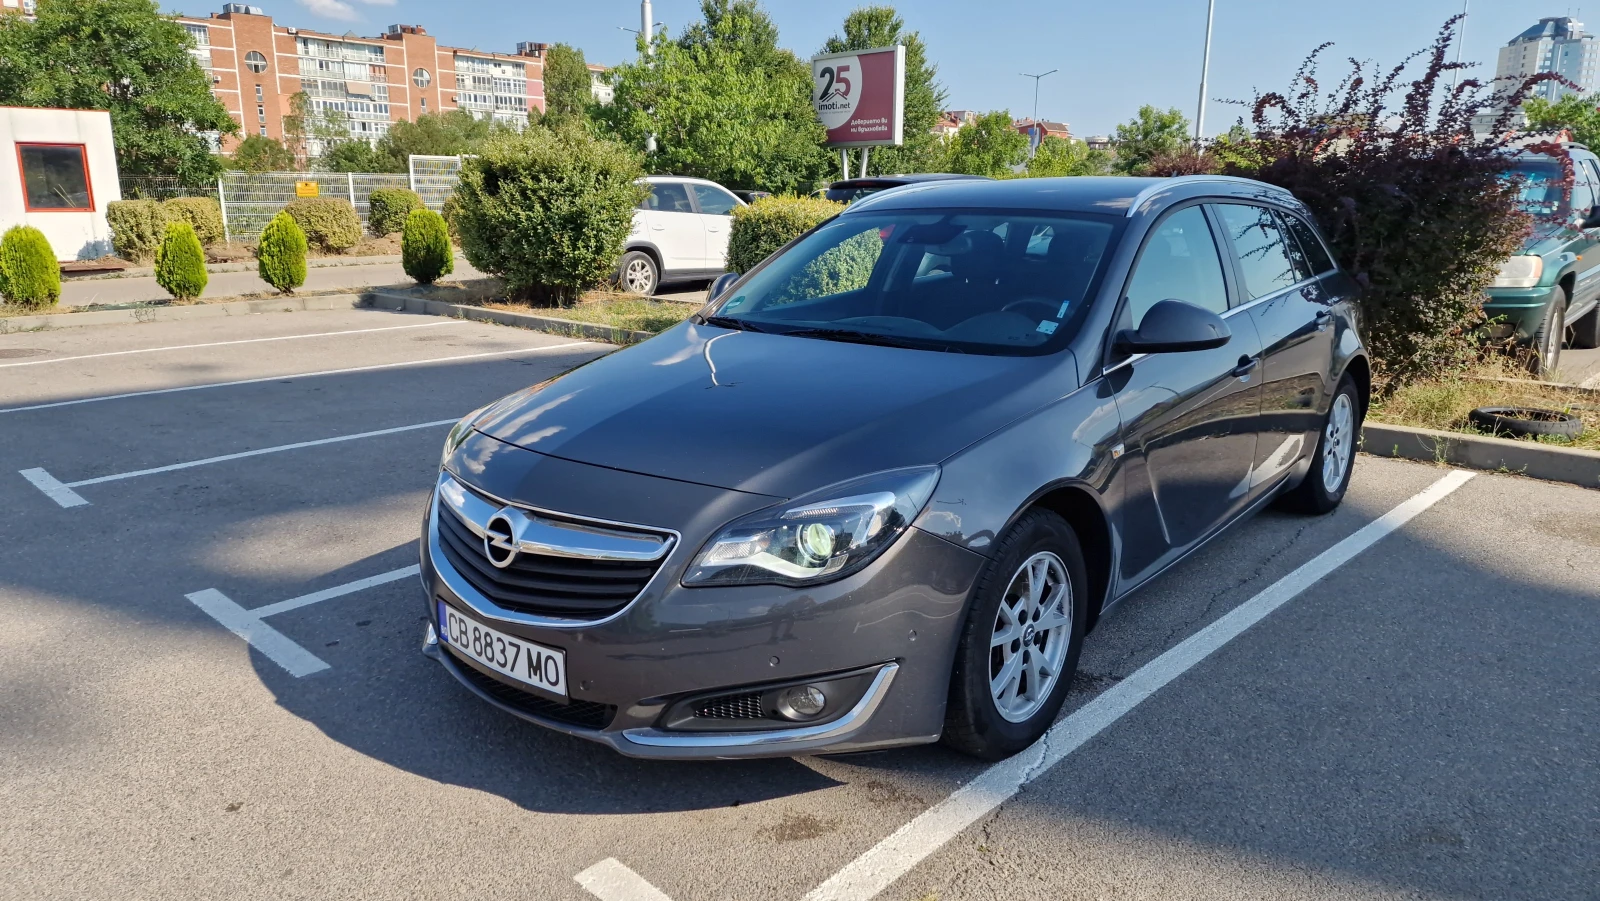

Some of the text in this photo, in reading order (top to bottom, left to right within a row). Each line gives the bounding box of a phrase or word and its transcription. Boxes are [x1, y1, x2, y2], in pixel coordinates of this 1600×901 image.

[819, 65, 851, 100] 25
[818, 101, 850, 110] imoti.net
[448, 612, 560, 687] CB 8837 MO
